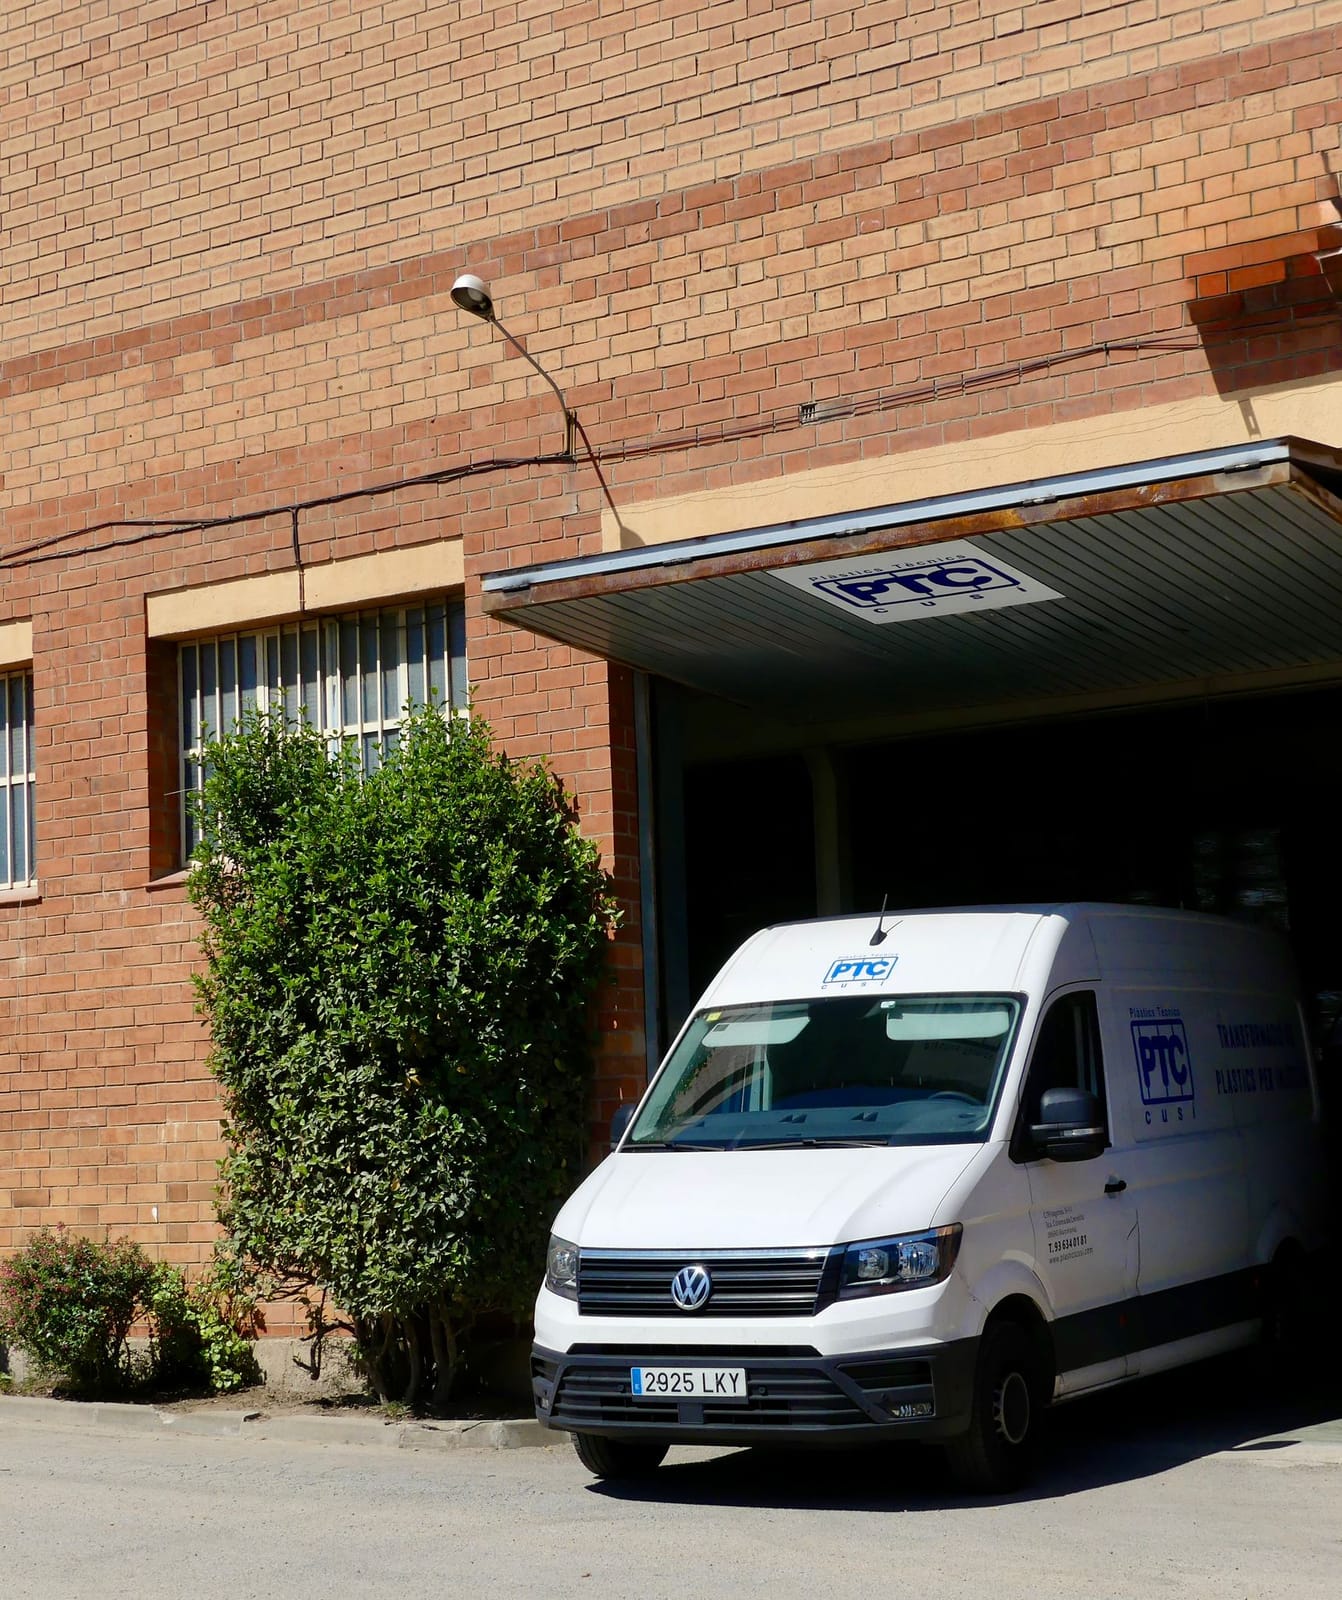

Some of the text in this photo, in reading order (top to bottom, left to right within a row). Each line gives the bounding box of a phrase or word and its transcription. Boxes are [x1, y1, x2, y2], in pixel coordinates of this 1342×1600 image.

[836, 567, 993, 602] PTC
[873, 585, 1027, 614] CUSI
[831, 960, 890, 979] PTC
[1138, 1034, 1188, 1089] PTC
[1144, 1101, 1196, 1125] CUSI
[645, 1372, 694, 1393] 2925
[702, 1372, 739, 1393] LKY
